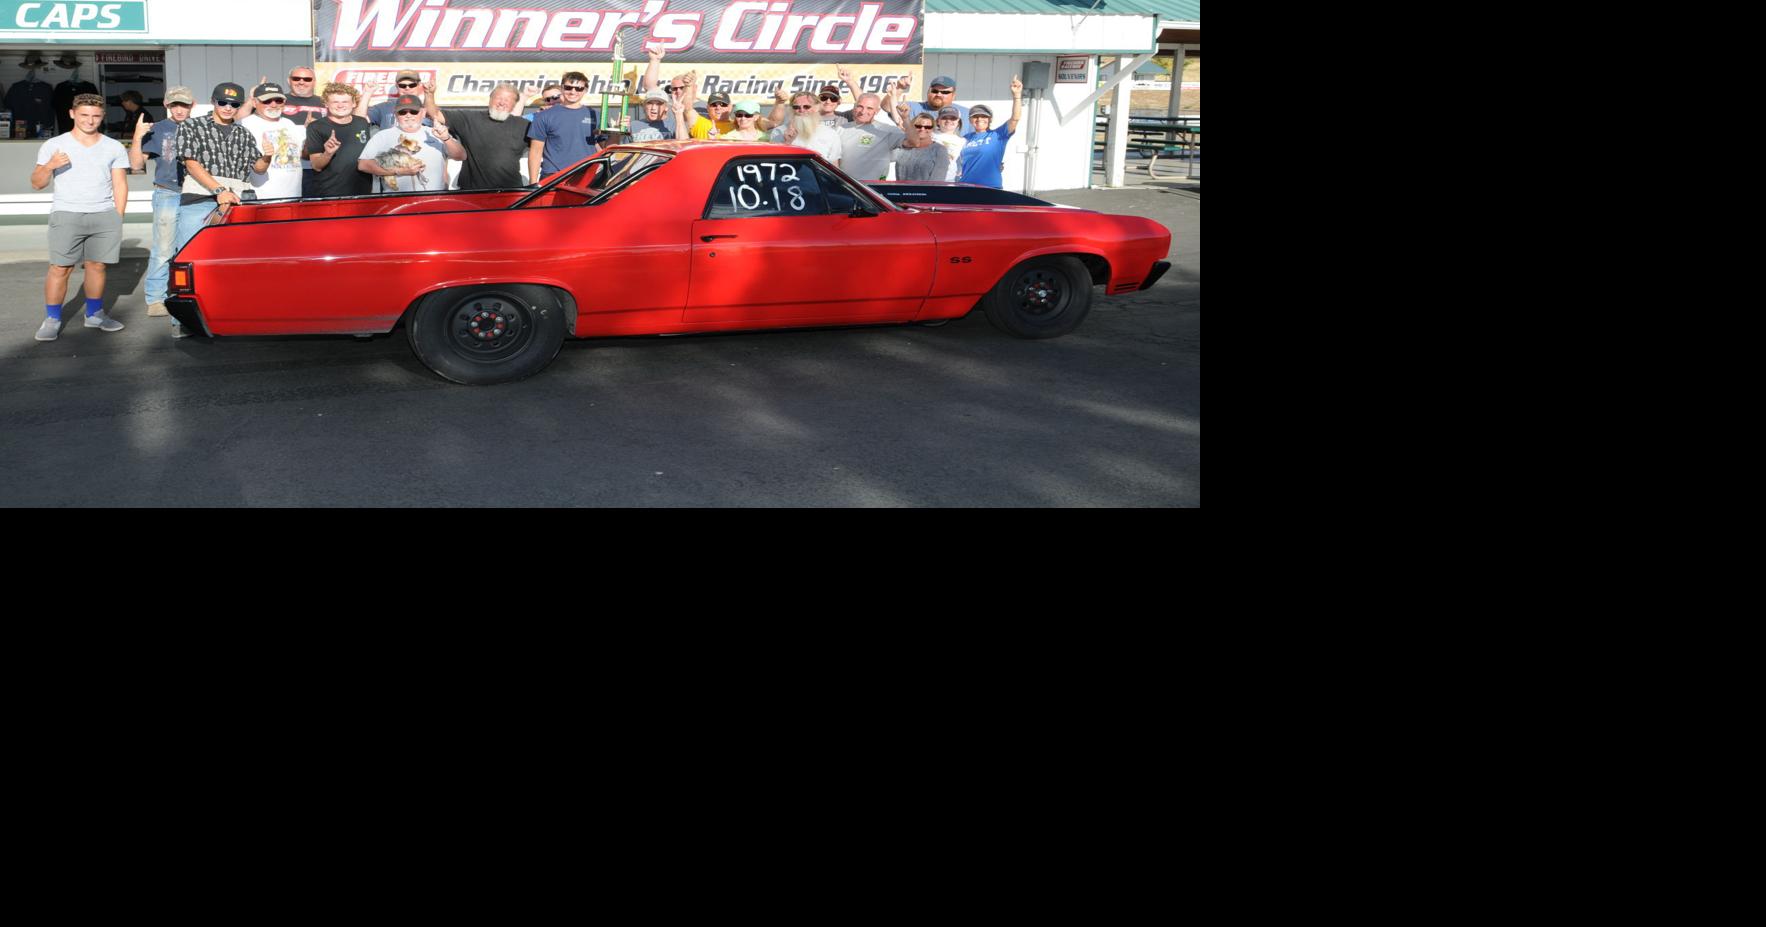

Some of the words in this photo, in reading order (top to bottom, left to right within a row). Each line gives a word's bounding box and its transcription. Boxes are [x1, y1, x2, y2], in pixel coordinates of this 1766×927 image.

[15, 2, 122, 28] CAPS
[332, 0, 702, 51] Winner's
[711, 0, 917, 53] Circle
[447, 75, 631, 98] Chapihip
[701, 75, 784, 98] Racing
[737, 162, 801, 183] 1972
[729, 184, 806, 213] 10.18
[950, 256, 972, 264] SS
